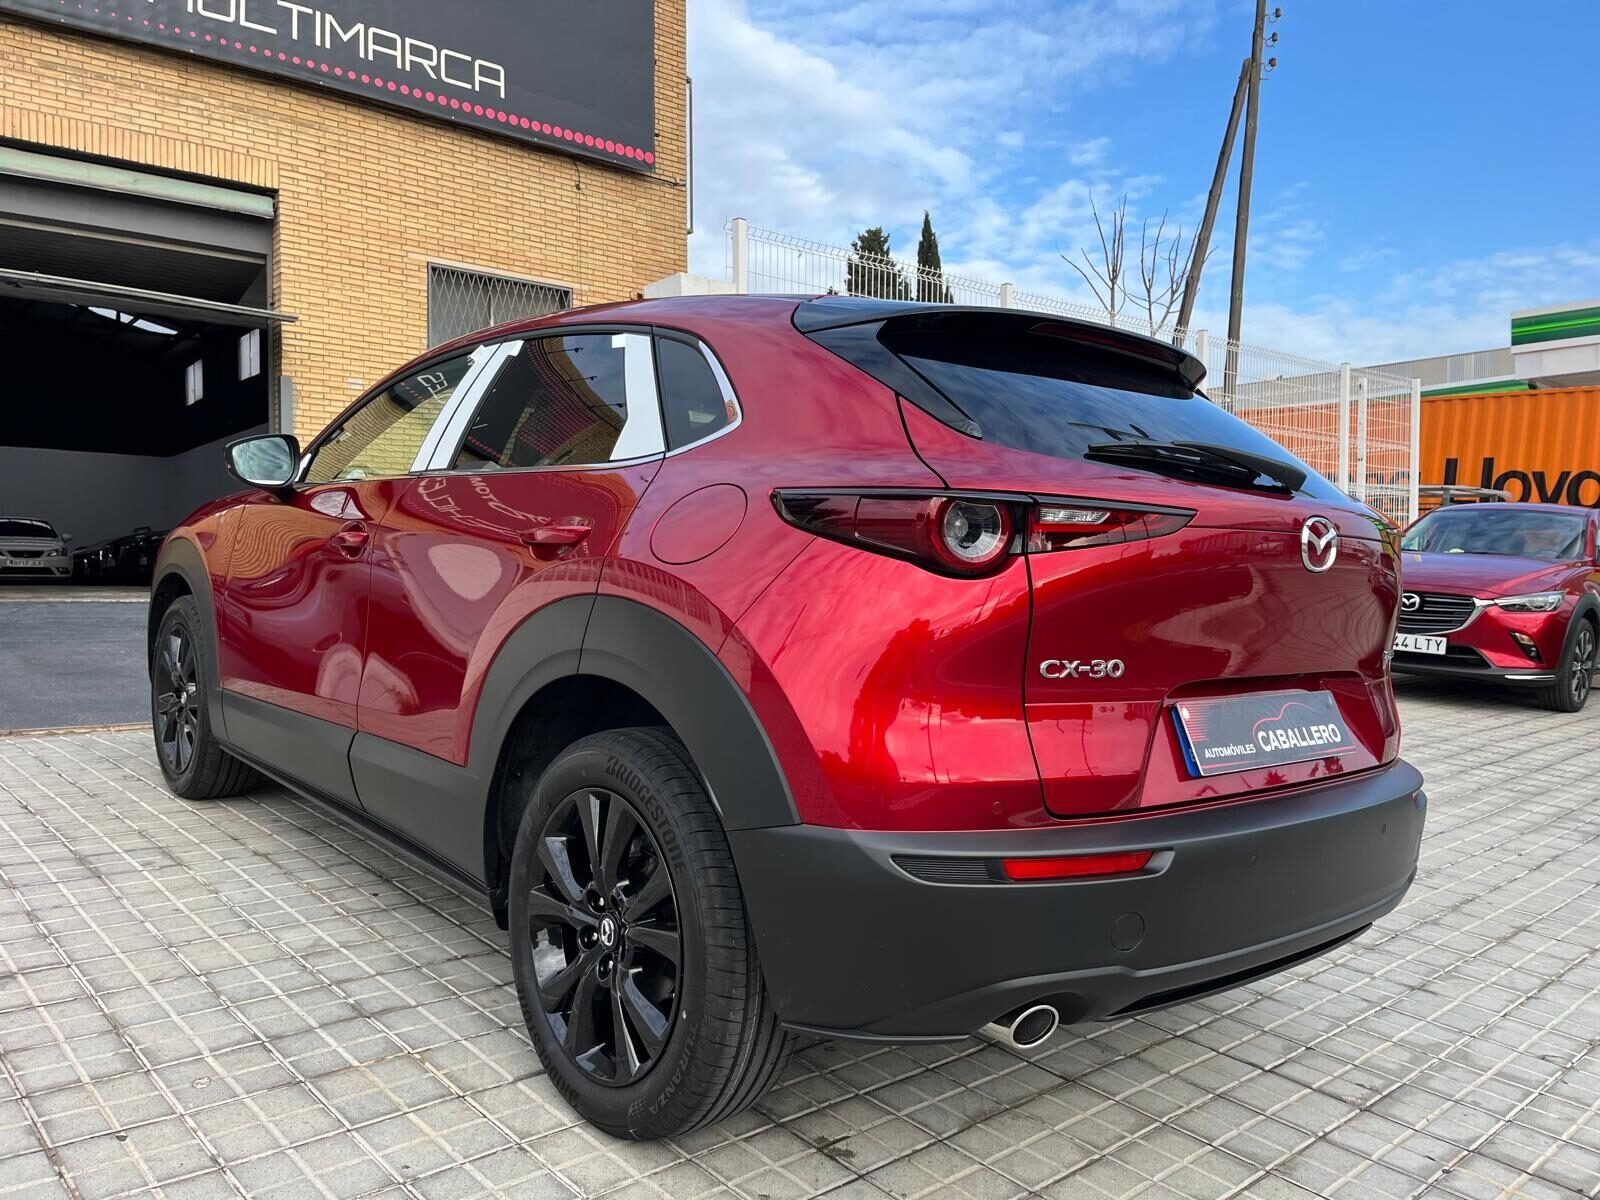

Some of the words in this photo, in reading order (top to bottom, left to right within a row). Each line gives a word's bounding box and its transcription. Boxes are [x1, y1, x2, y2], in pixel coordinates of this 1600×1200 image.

[1414, 637, 1443, 652] LTY
[1040, 659, 1125, 678] CX-30
[1205, 743, 1256, 759] AUTOMÓVILES
[1257, 723, 1342, 752] CABALLERO
[604, 755, 688, 877] BRIDGESTONE
